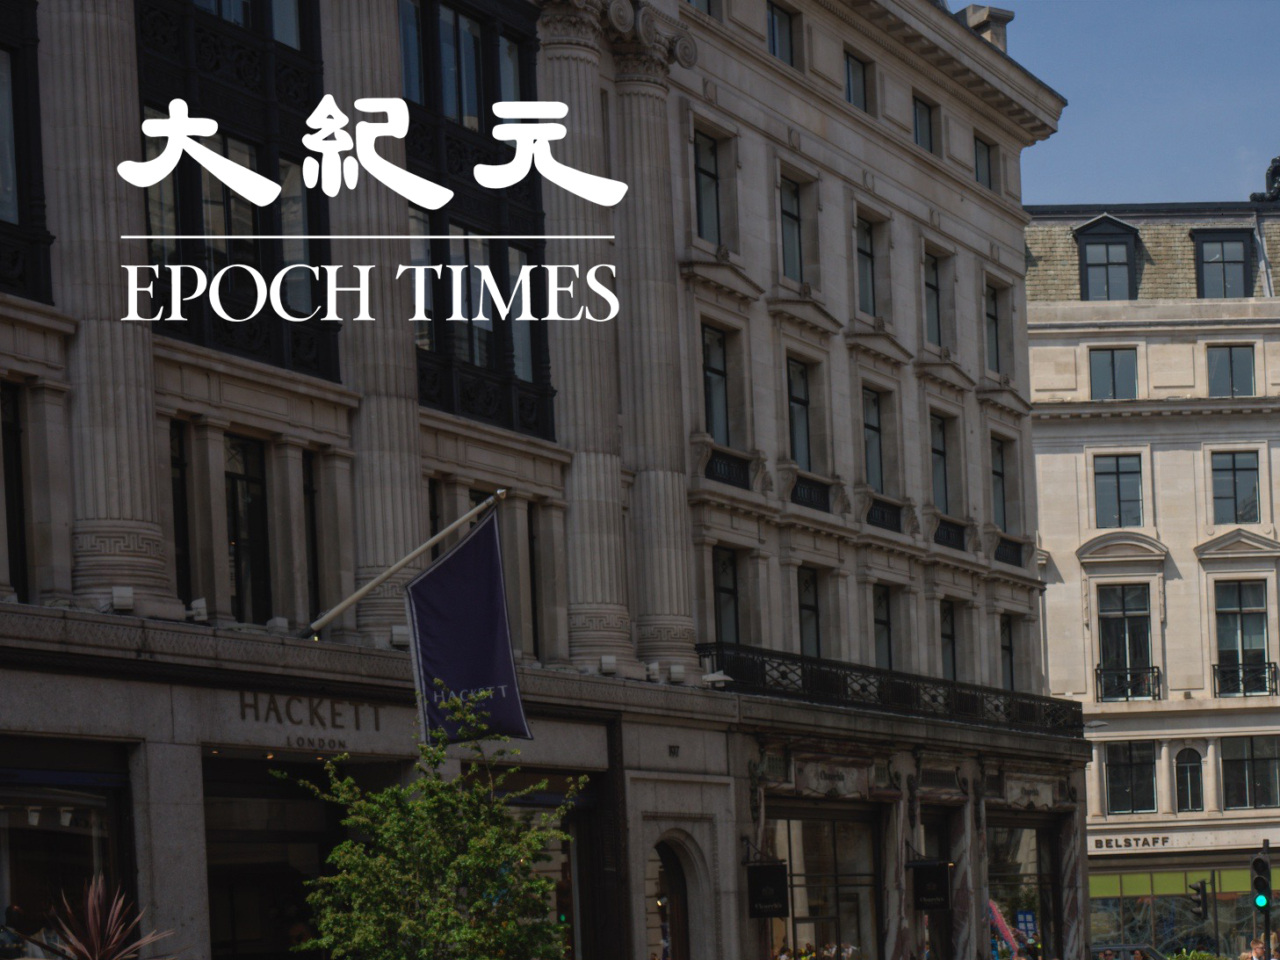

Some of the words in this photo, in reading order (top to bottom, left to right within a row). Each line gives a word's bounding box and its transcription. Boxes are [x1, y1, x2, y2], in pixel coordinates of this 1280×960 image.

[239, 690, 384, 732] HACKETT
[286, 735, 347, 750] LONDON
[668, 745, 679, 757] 197
[1095, 837, 1169, 848] BELSTAFF
